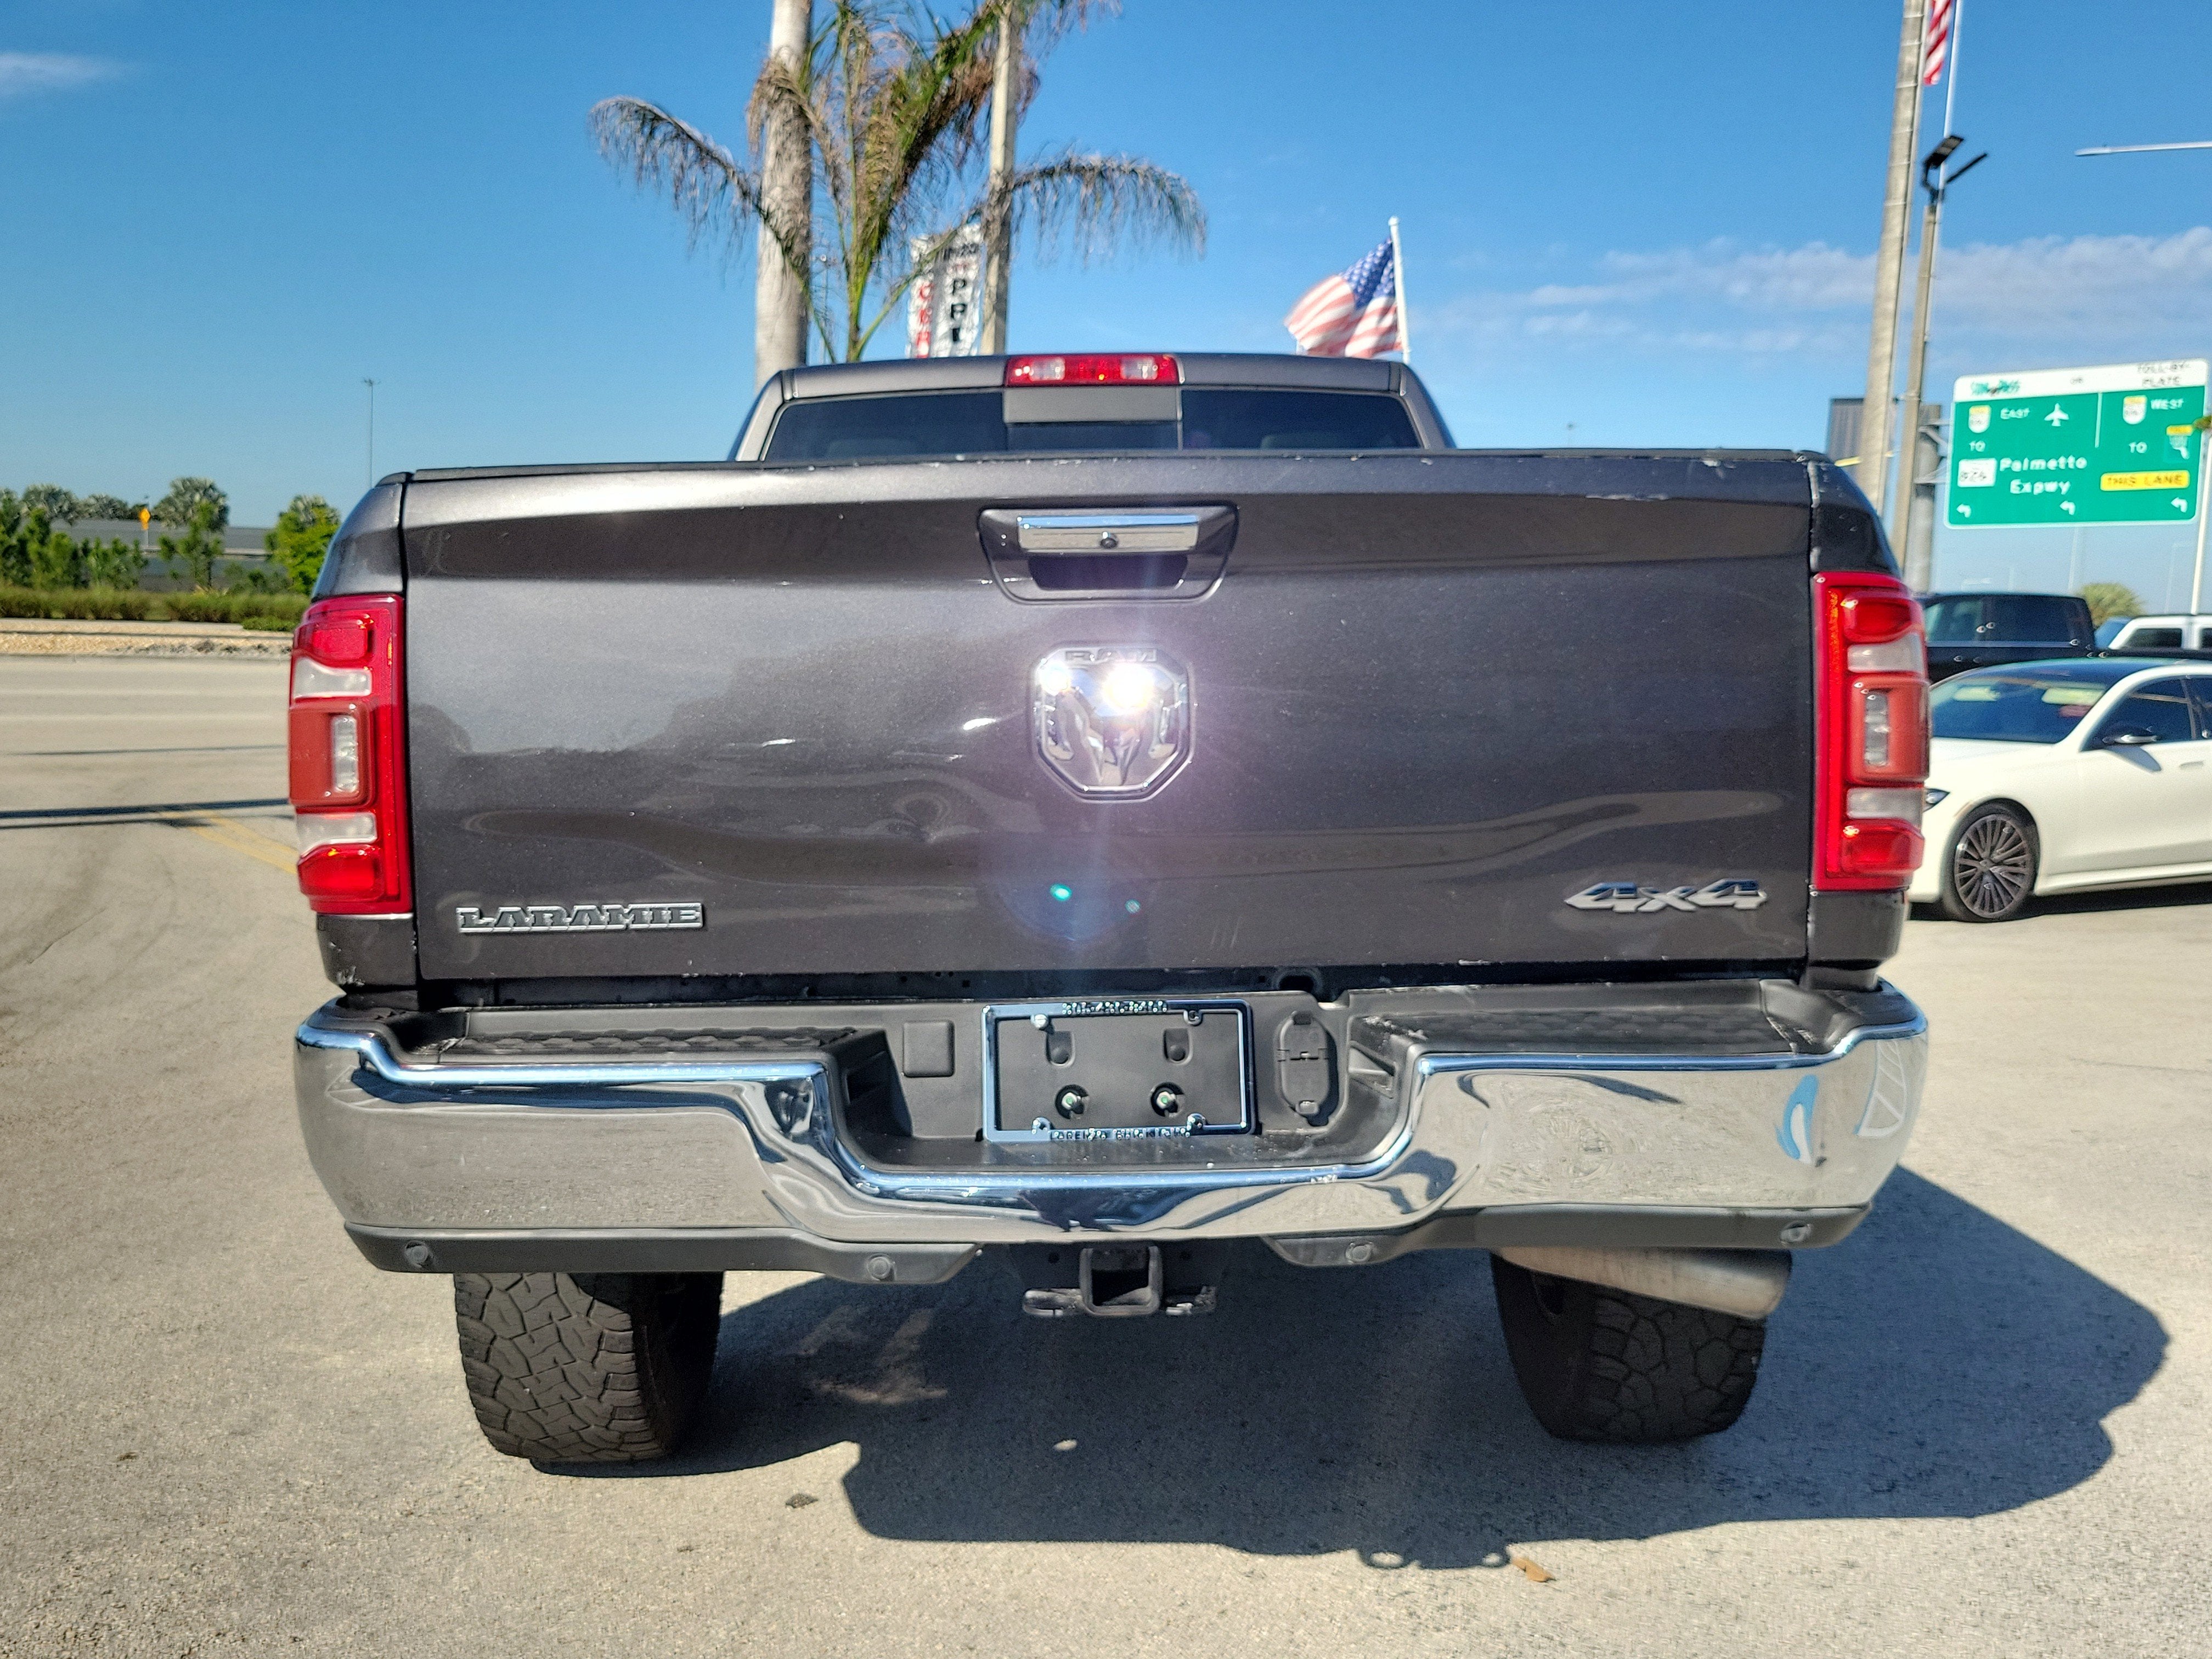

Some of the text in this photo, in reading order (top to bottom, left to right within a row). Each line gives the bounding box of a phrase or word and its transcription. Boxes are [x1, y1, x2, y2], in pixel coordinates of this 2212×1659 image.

[2151, 398, 2184, 410] WEST
[2000, 407, 2030, 420] EAST
[1968, 440, 1986, 452] TO
[2129, 441, 2147, 454] TO
[2000, 455, 2087, 472] Palmetto
[2010, 478, 2071, 495] Expwy
[2107, 474, 2183, 487] THIS LANE
[456, 901, 704, 934] LARAMIE
